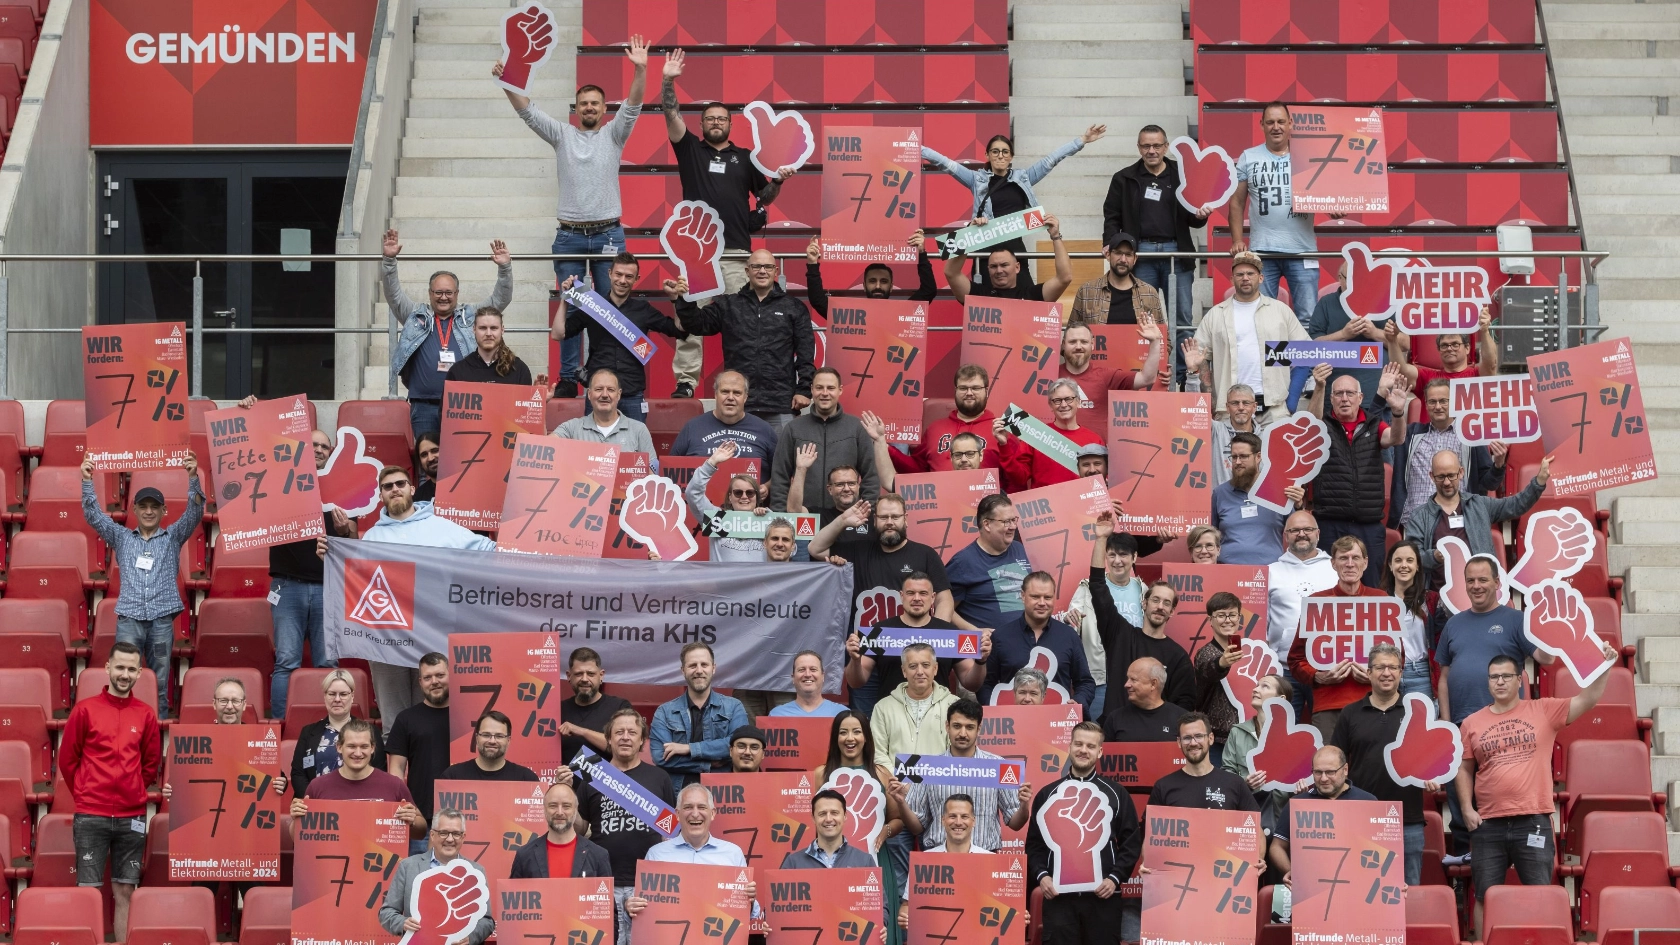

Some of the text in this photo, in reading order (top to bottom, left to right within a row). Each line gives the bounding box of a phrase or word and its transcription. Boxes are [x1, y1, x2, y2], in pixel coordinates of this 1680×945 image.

[126, 24, 356, 63] GEMÜNDEN
[1292, 114, 1325, 124] WIR
[828, 136, 862, 152] WIR
[828, 153, 862, 162] fordern:
[1291, 134, 1348, 190] 7
[1253, 162, 1288, 174] CAMP
[1253, 173, 1289, 187] DAVID
[842, 173, 872, 222] 7
[1258, 187, 1282, 216] 63
[946, 216, 1024, 253] Solidarität
[823, 252, 892, 261] Elektroindustrie
[866, 244, 896, 252] Metall-
[1396, 272, 1484, 299] MEHR
[567, 286, 636, 342] Antifaschismus
[832, 308, 866, 325] WIR
[968, 306, 1002, 324] WIR
[1401, 302, 1480, 329] GELD
[832, 324, 866, 336] fordern:
[968, 322, 1002, 334] fordern:
[86, 336, 122, 354] WIR
[1266, 347, 1357, 360] Antifaschismus
[88, 354, 124, 364] fordern:
[1533, 361, 1570, 382] WIR
[1536, 379, 1574, 392] fordern:
[96, 374, 136, 429] 7
[448, 392, 482, 410] WIR
[1112, 401, 1148, 418] WIR
[446, 410, 482, 420] fordern:
[1113, 418, 1149, 428] fordern:
[1550, 392, 1591, 454] 7
[210, 417, 247, 438] WIR
[1462, 410, 1538, 441] GELD
[213, 434, 249, 448] fordern:
[702, 430, 726, 442] URBAN
[728, 430, 757, 442] EDITION
[897, 432, 920, 441] 2024
[88, 448, 189, 462] Tarifrunde Metall- und
[519, 443, 555, 462] WIR
[95, 459, 164, 470] lektroindustrie
[216, 450, 266, 474] Fette
[516, 458, 553, 470] fordern:
[1118, 438, 1162, 502] 7
[1552, 460, 1654, 486] Tarifrunde Metall- und
[1555, 468, 1654, 496] Elektroindustrie 2024
[244, 469, 268, 514] 7
[436, 506, 480, 518] Tarifrunde
[1015, 498, 1052, 520] WIR
[712, 516, 794, 533] Solidar
[1021, 516, 1056, 529] fordern:
[1156, 515, 1209, 524] Metall- und
[224, 516, 322, 542] Tarifrunde Metall- und
[225, 526, 323, 550] Elektroindustrie 2024
[1026, 529, 1070, 599] 7
[448, 584, 811, 620] Betriebsrat und Vertrauensleute
[1306, 602, 1401, 632] MEHR
[344, 628, 414, 646] Bad Kreuznach
[540, 618, 716, 644] der Firma KHS
[454, 646, 492, 663] WIR
[454, 665, 492, 674] fordern:
[174, 736, 212, 754] WIR
[174, 755, 212, 764] fordern:
[896, 763, 996, 778] Antifaschismus
[572, 754, 660, 816] Antirassismus
[188, 779, 226, 837] 7
[300, 812, 339, 830] WIR
[1150, 818, 1190, 838] WIR
[1295, 811, 1334, 829] WIR
[300, 830, 339, 841] fordern:
[1150, 837, 1190, 848] fordern:
[1296, 829, 1335, 840] fordern:
[170, 858, 278, 868] Tarifrunde Metall- und
[172, 868, 277, 878] Elektroindustrie 2024
[316, 856, 354, 907] 7
[640, 872, 680, 892] WIR
[914, 865, 955, 884] WIR
[770, 882, 811, 900] WIR
[914, 885, 954, 896] fordern:
[1302, 846, 1351, 922] 7
[502, 891, 542, 910] WIR
[640, 892, 680, 904] fordern:
[771, 902, 812, 912] fordern:
[502, 912, 542, 920] fordern:
[1294, 932, 1404, 944] Tarifrunde Metall- und
